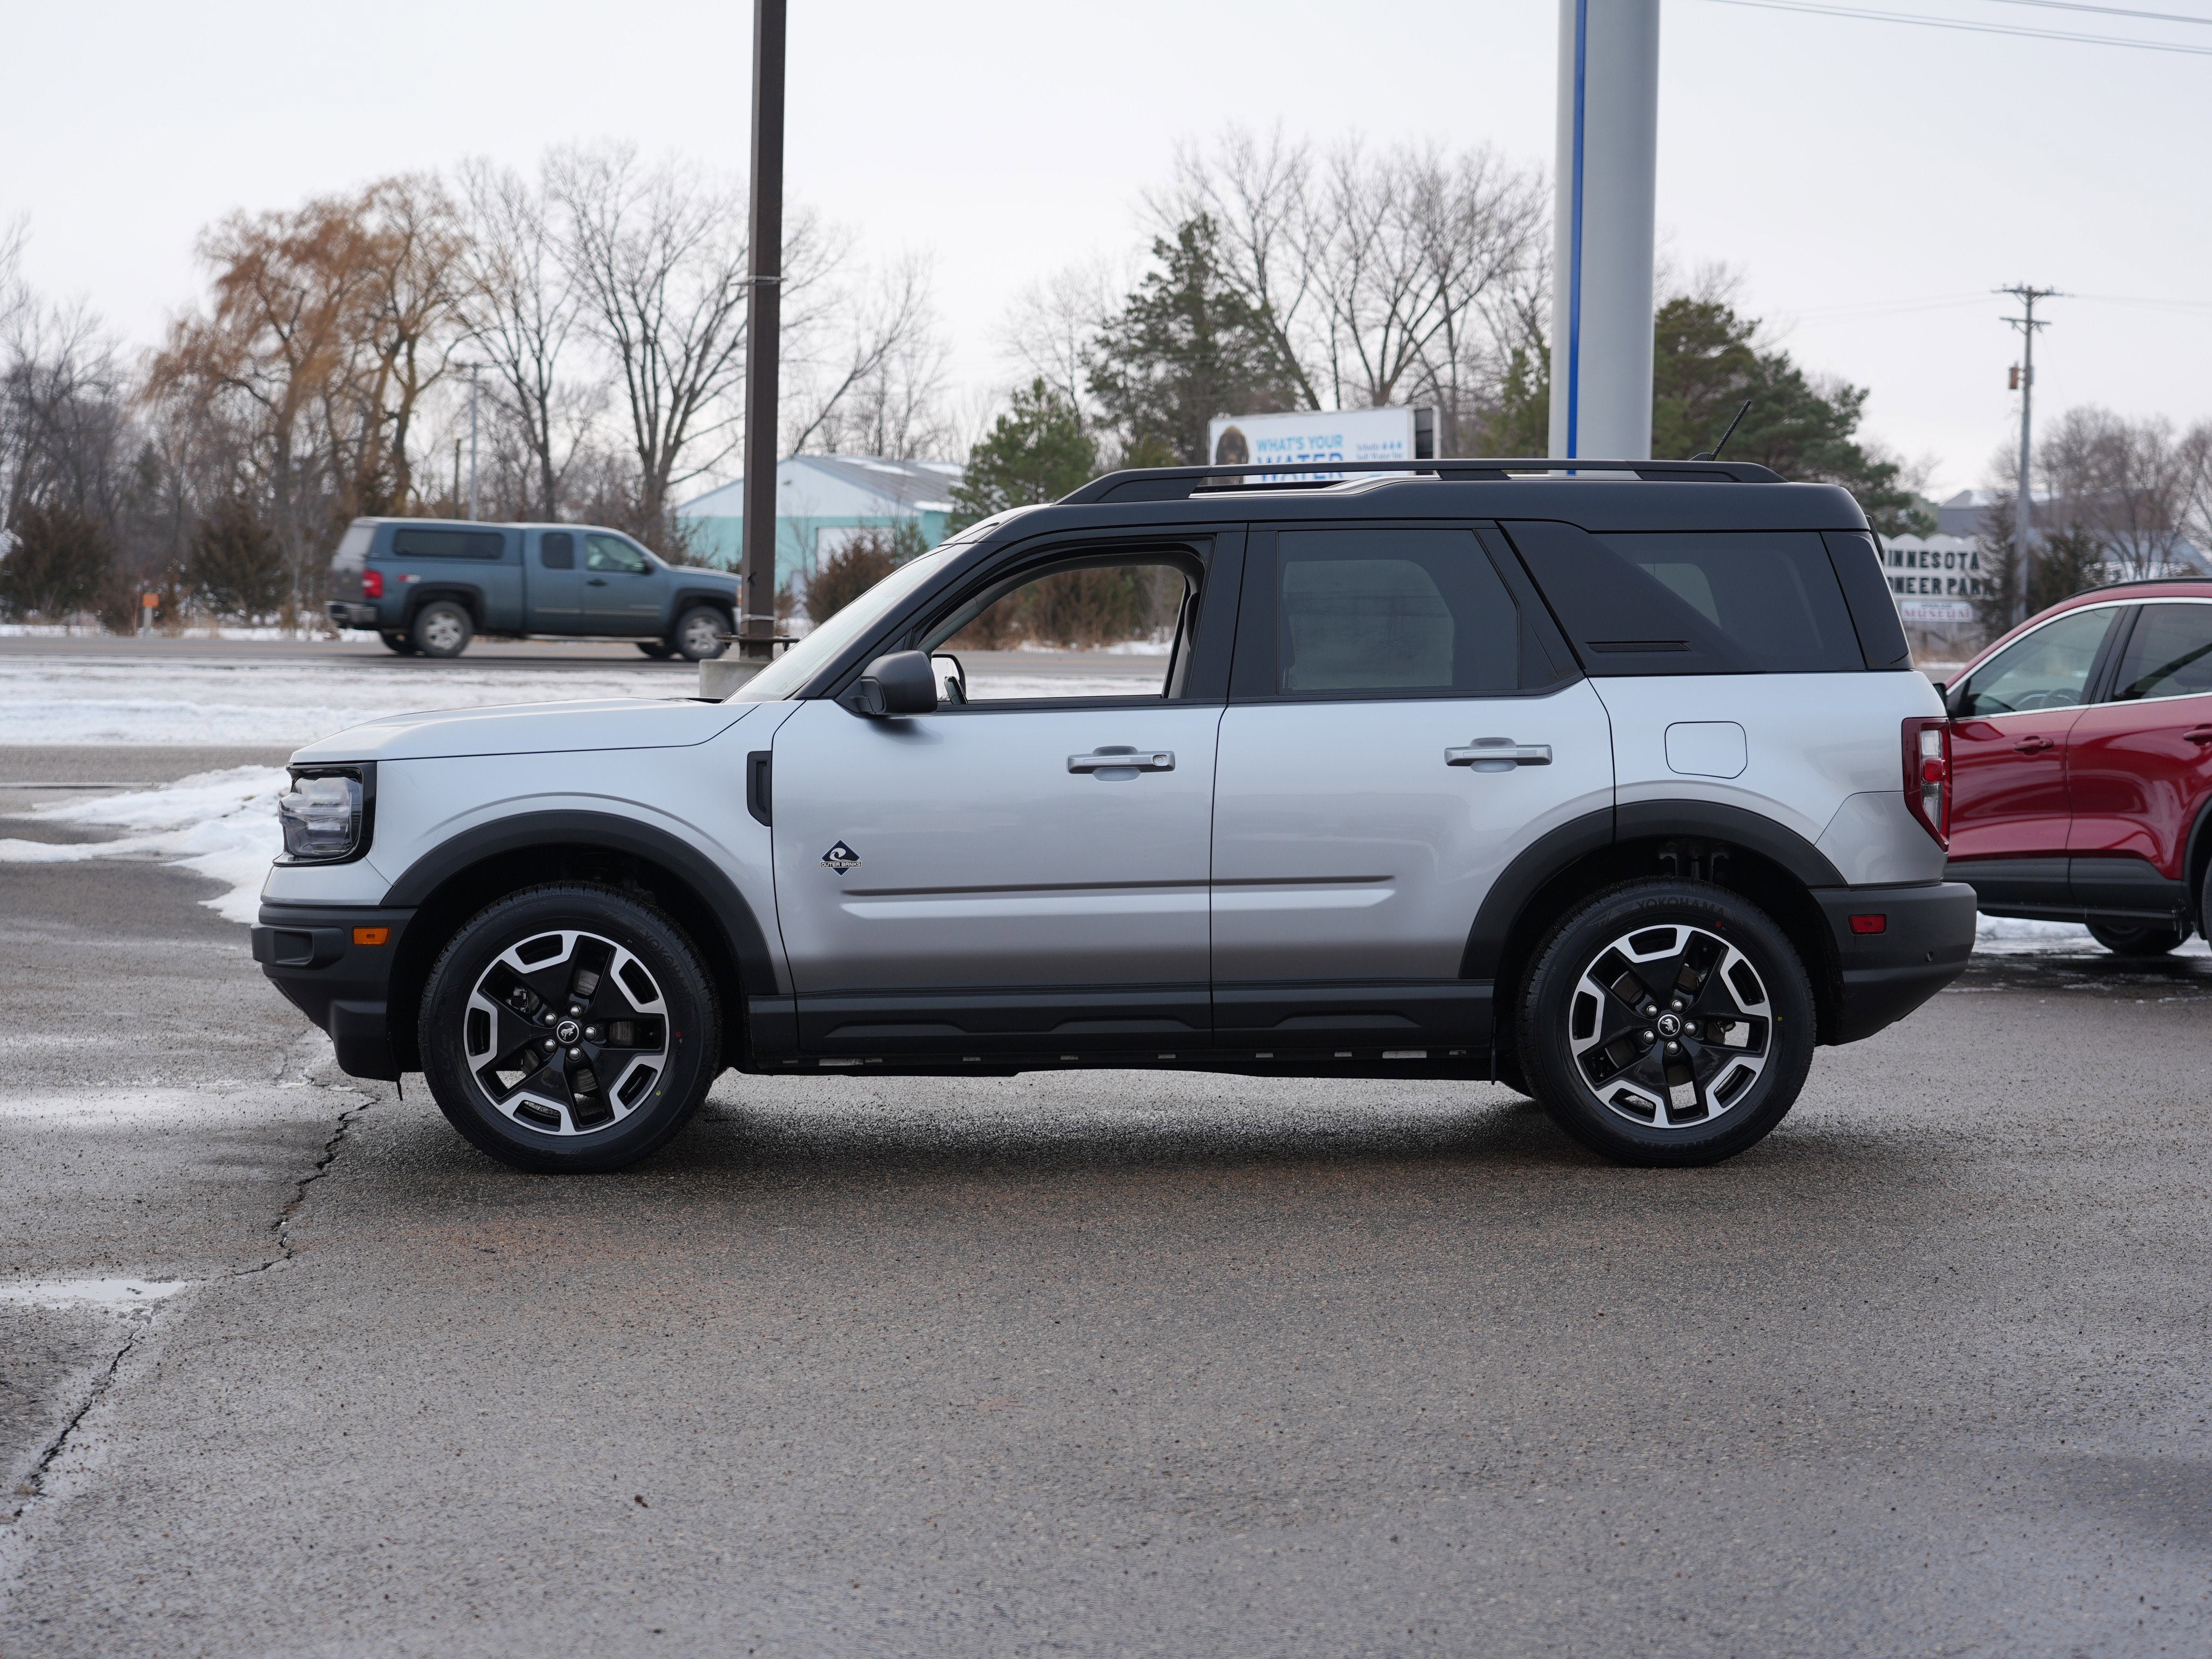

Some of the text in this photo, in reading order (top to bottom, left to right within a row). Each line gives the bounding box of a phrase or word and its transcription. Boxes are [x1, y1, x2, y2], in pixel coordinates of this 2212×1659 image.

[1256, 434, 1343, 451] WHAT'S YOUR
[1883, 550, 1979, 570] INNESOTA
[1636, 896, 1724, 917] YOKOHAMA
